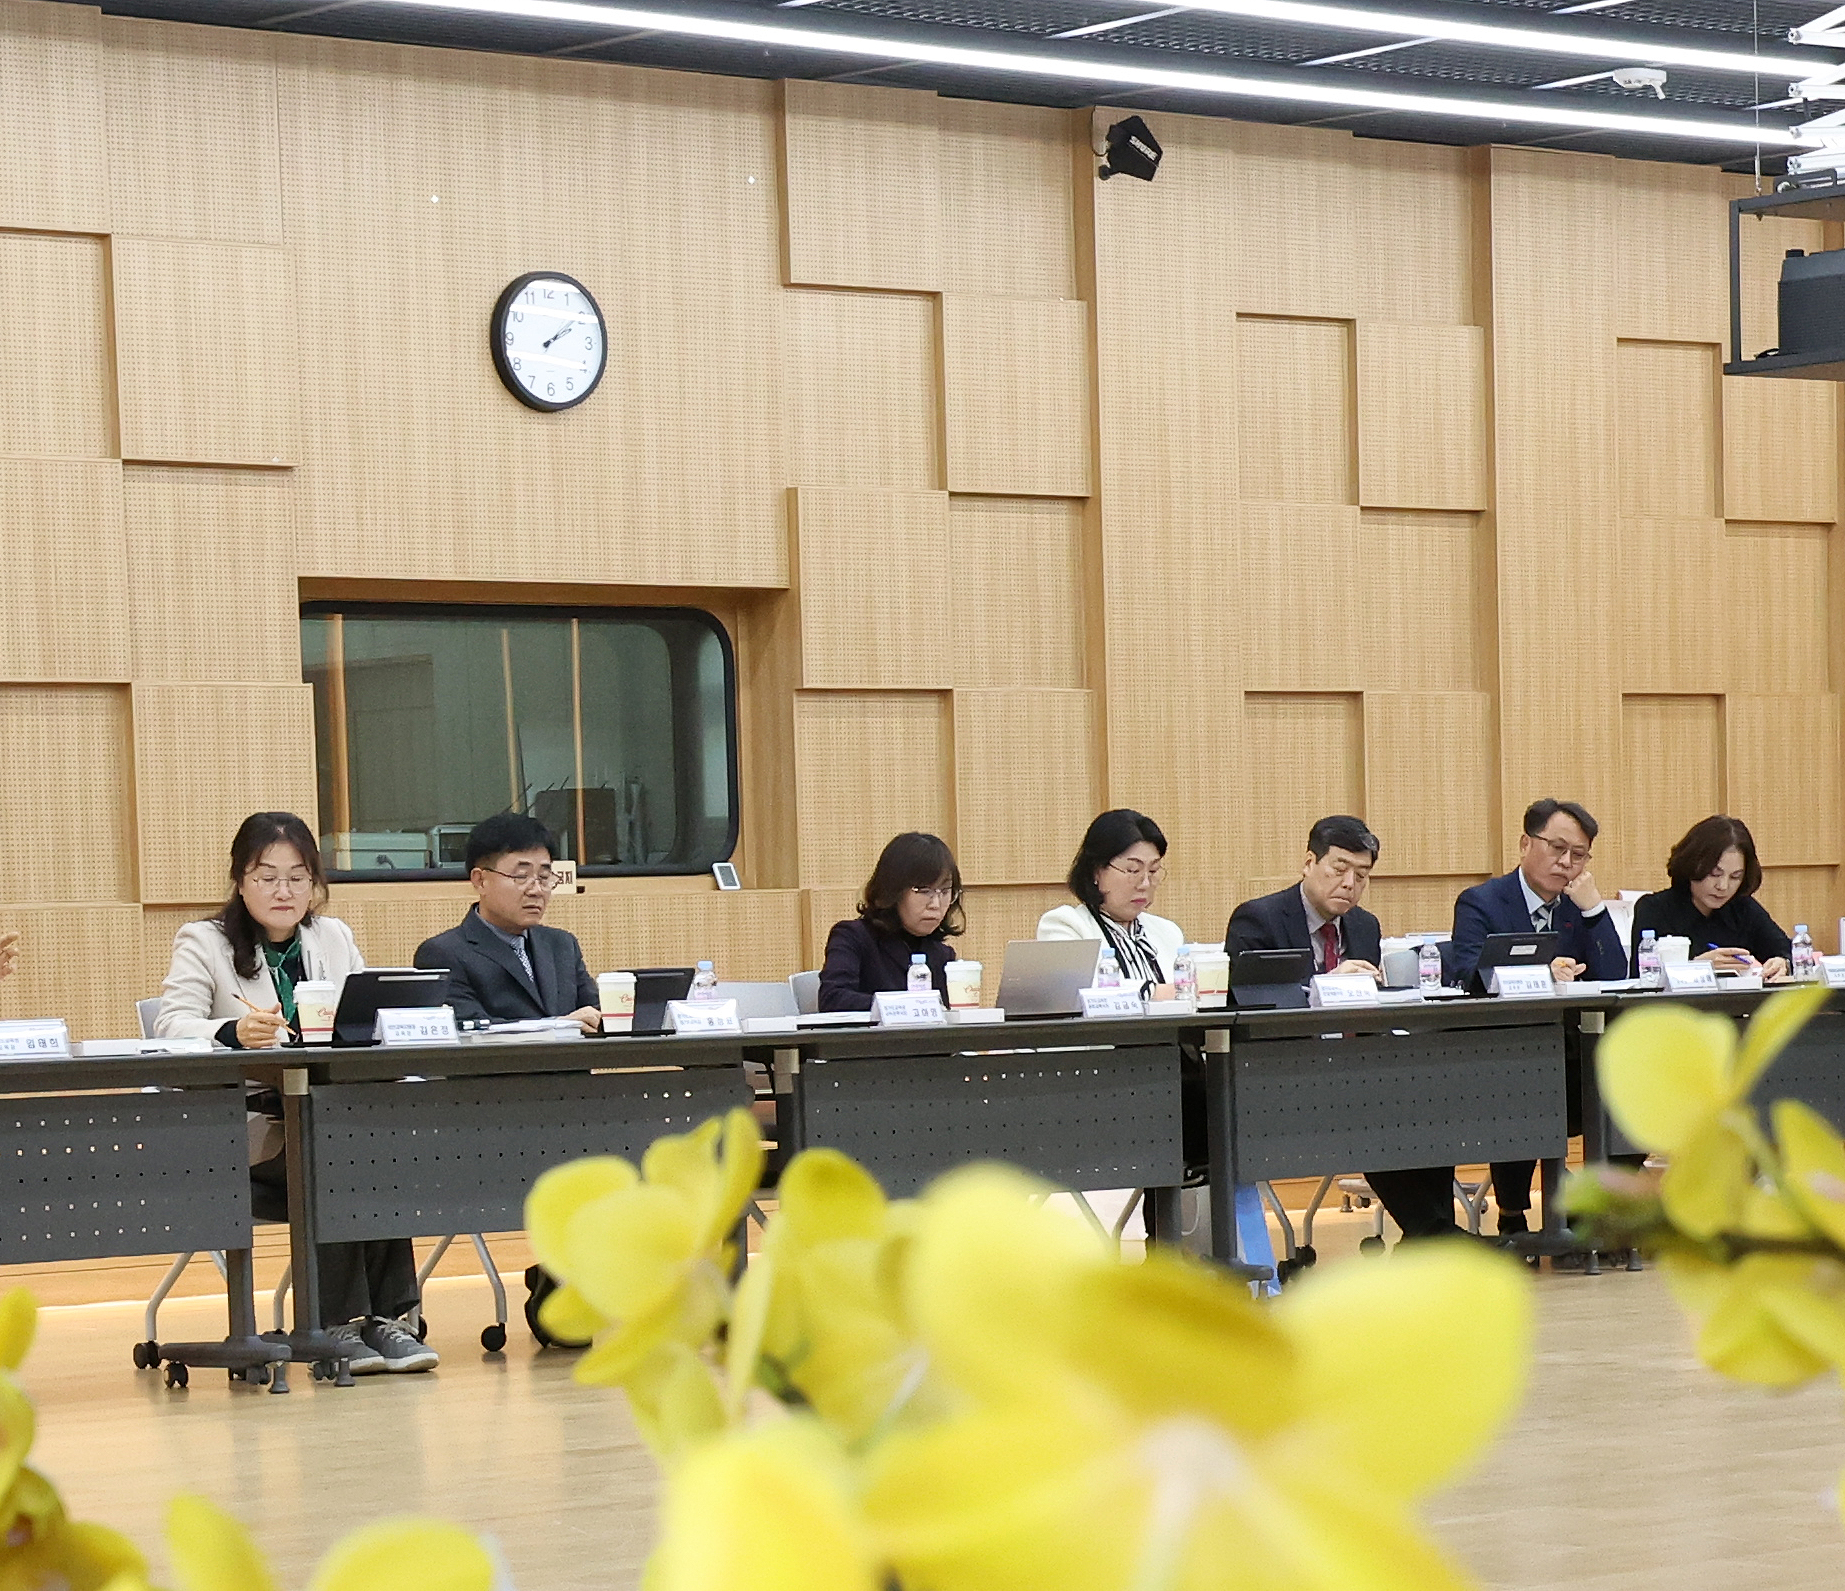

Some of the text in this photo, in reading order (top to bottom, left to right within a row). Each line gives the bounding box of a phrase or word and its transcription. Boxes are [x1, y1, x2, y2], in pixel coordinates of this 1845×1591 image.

[524, 290, 535, 305] 11
[564, 293, 570, 306] 1
[511, 311, 524, 322] 10
[505, 332, 514, 346] 9
[585, 336, 593, 350] 3
[513, 357, 521, 371] 8
[528, 375, 536, 389] 7
[566, 377, 574, 390] 5
[547, 383, 555, 396] 6
